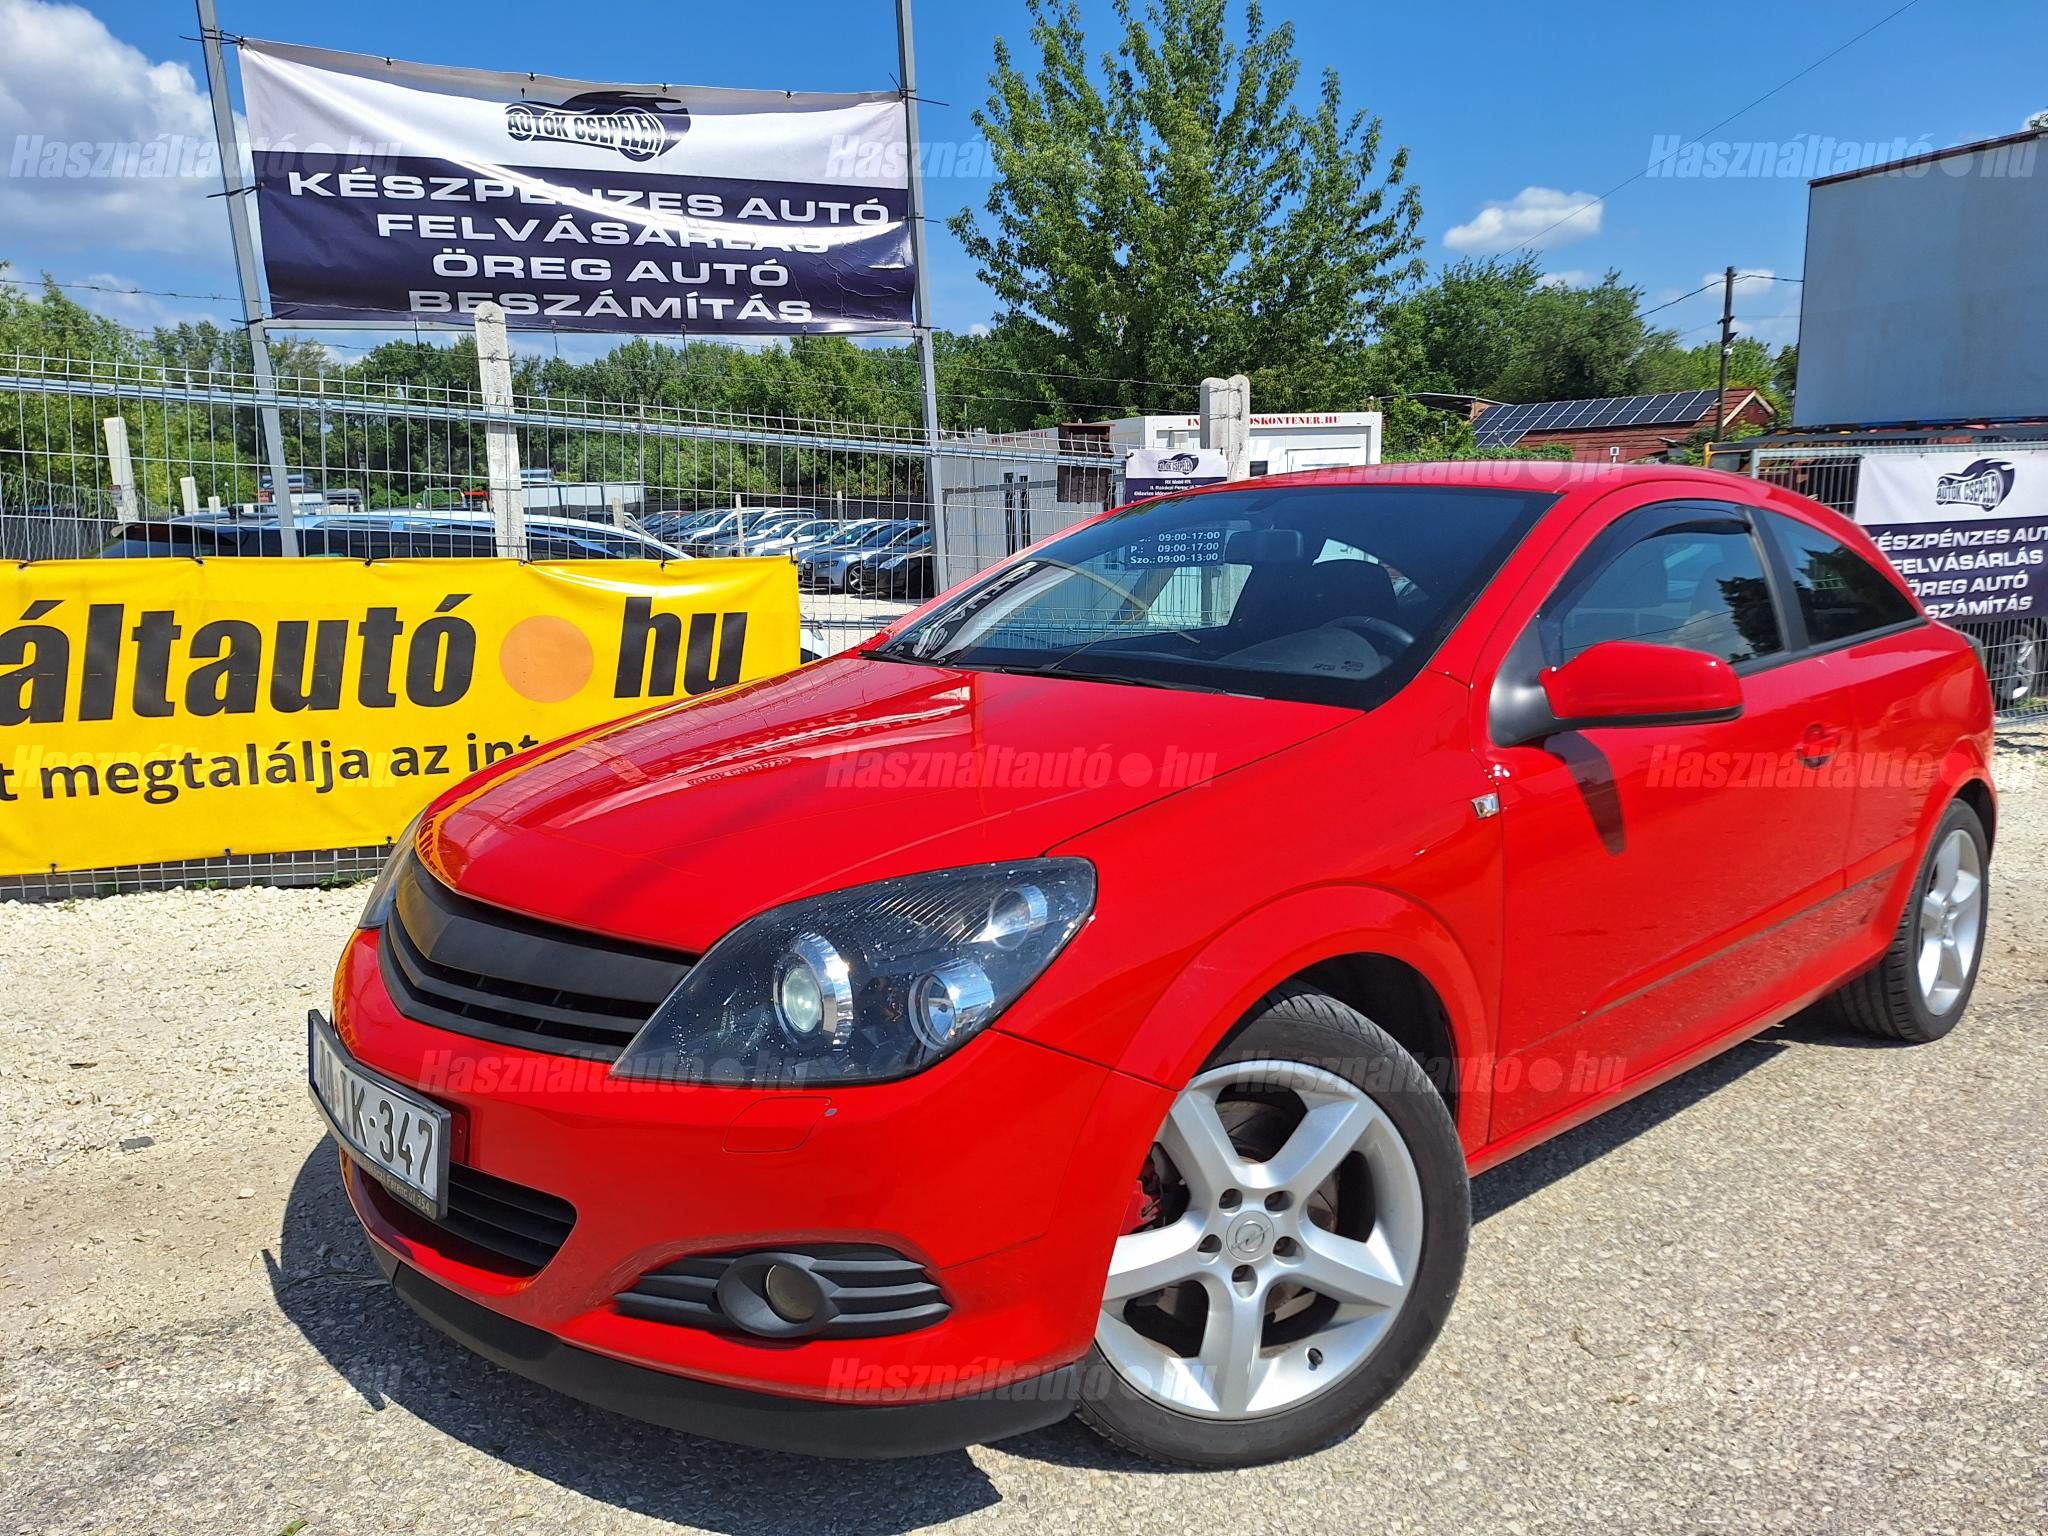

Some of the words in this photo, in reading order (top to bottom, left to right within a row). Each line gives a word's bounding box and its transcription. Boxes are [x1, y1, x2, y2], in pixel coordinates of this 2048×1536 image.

[736, 197, 889, 226] AUTÓ
[432, 247, 612, 282] ÖREG
[625, 258, 789, 287] AUTÓ
[408, 289, 814, 324] BESZÁMÍTÁS
[1157, 542, 1219, 553] 09:00-17:00
[1158, 531, 1220, 542] 09:00-17:00
[1157, 552, 1218, 563] 09:00-13:00
[1969, 569, 2029, 593] AUTÓ
[613, 595, 749, 698] hu
[40, 739, 369, 805] megtalálja
[390, 743, 450, 777] az
